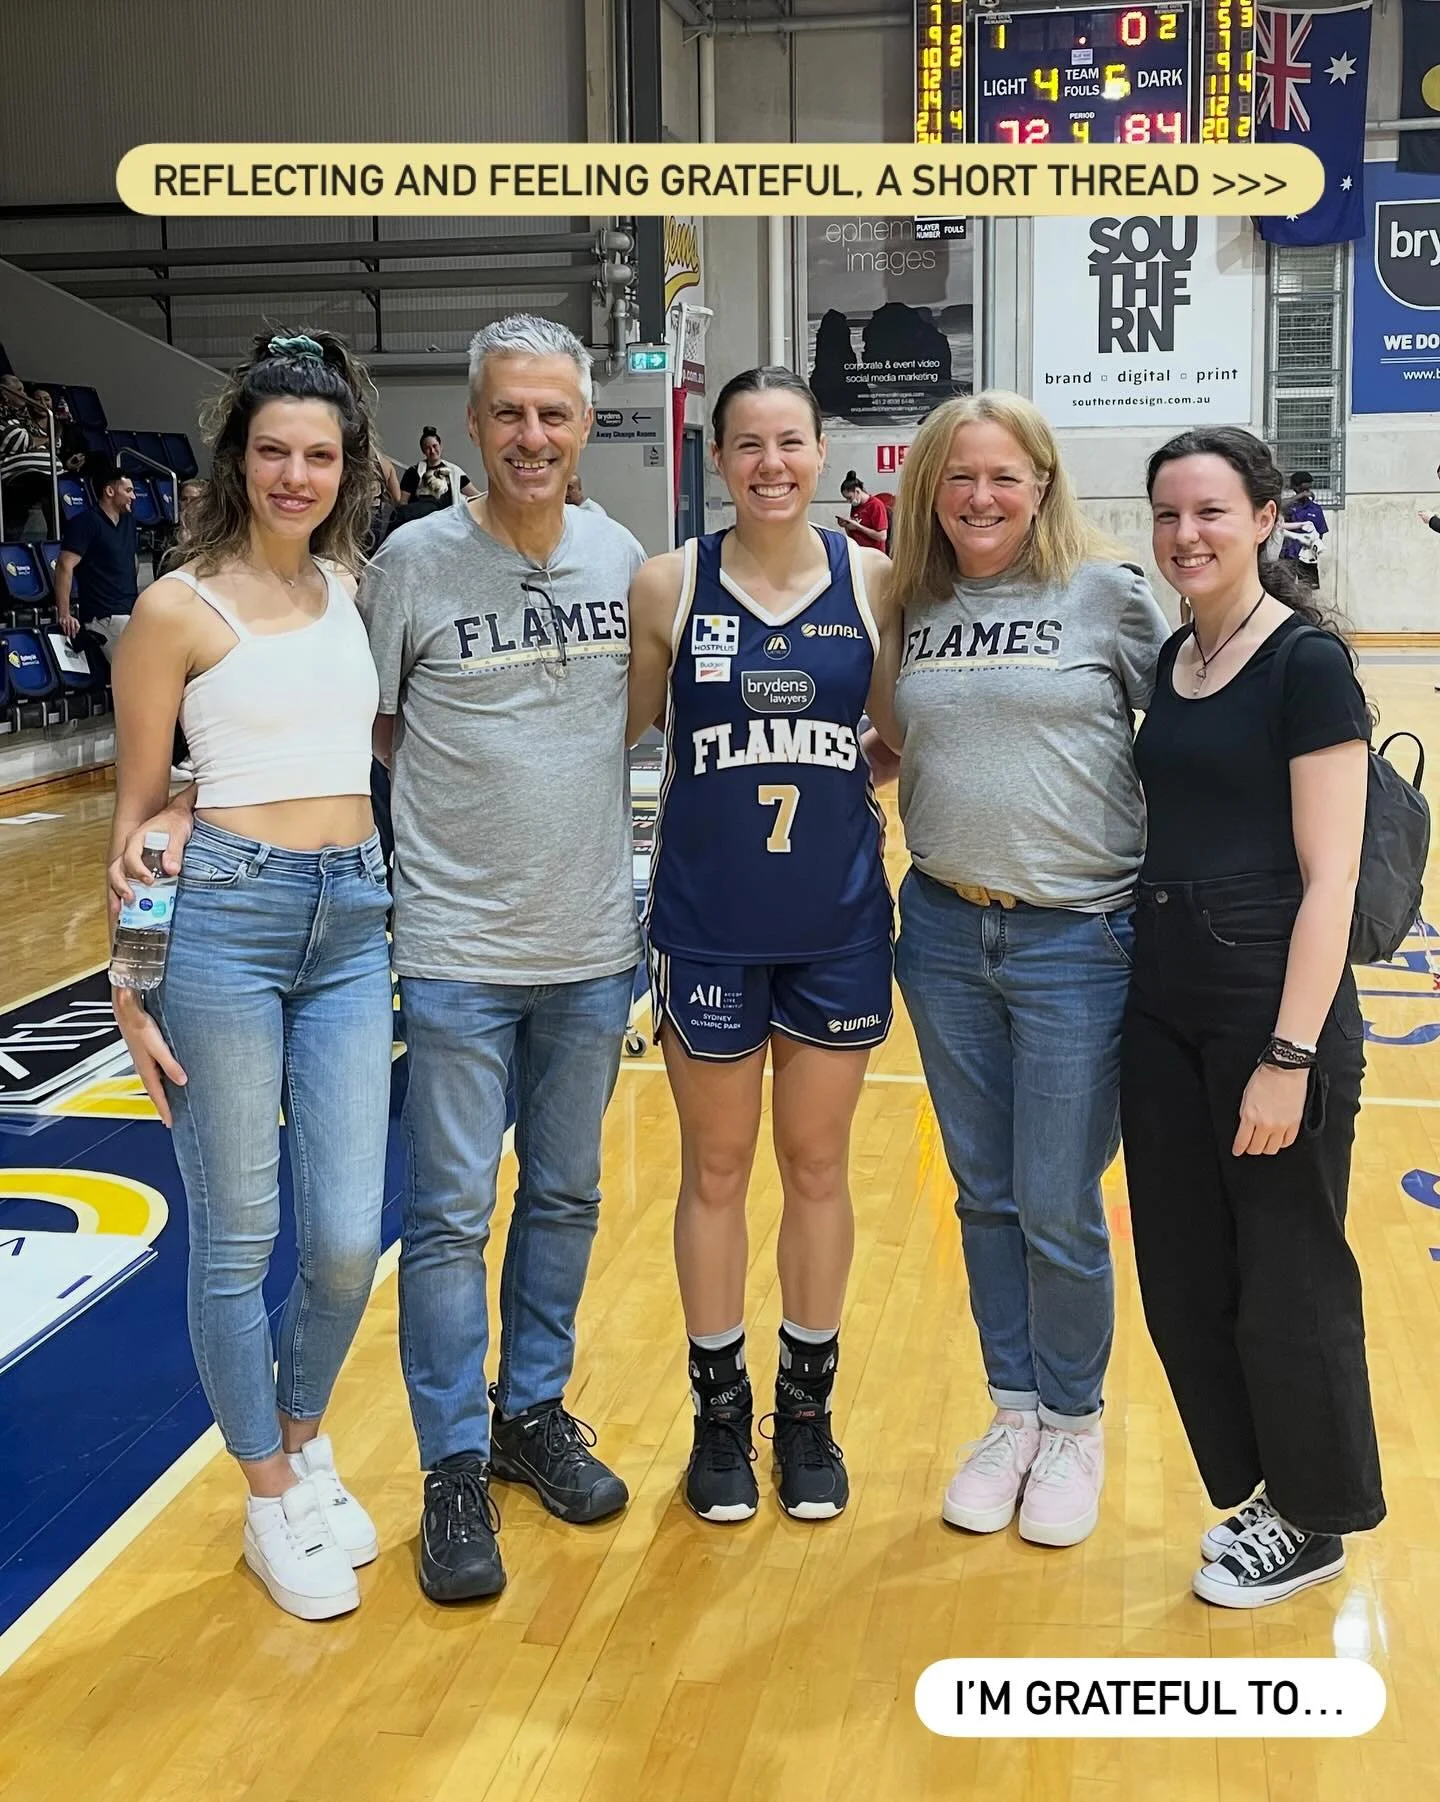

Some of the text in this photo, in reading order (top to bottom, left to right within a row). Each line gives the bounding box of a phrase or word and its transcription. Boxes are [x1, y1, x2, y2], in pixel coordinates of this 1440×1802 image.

[928, 24, 962, 46] 9 2
[1159, 13, 1177, 40] 2
[1218, 29, 1231, 51] 7
[923, 46, 962, 68] 10 2
[1217, 52, 1231, 73] 9
[923, 69, 942, 89] 12
[1065, 67, 1099, 81] TEAM
[1137, 69, 1183, 89] DARK
[1210, 73, 1251, 95] 11 4
[983, 78, 1028, 96] LIGHT
[1034, 67, 1059, 102] 4
[1064, 85, 1100, 97] FOULS
[923, 89, 942, 111] 14
[1210, 95, 1230, 117] 12
[916, 109, 962, 132] 21 4
[1069, 111, 1095, 120] PERIOD
[1202, 116, 1251, 139] 20 2
[916, 223, 939, 232] PLAYER
[916, 231, 941, 239] NUMBER
[944, 225, 964, 234] FOULS
[847, 247, 936, 276] images
[1098, 306, 1174, 353] RN
[1383, 334, 1412, 350] WE
[843, 359, 940, 371] corporate & event video
[845, 372, 938, 383] social media marketing
[1045, 367, 1239, 386] brand digital print
[1072, 396, 1211, 407] southerndesign.com.au
[453, 600, 628, 658] FLAMES
[817, 624, 864, 639] WNBL
[694, 644, 734, 652] HOSTPLUS
[902, 620, 1063, 668] FLAMES
[747, 677, 808, 697] brydens
[770, 693, 807, 705] lawyers
[692, 718, 858, 776] FLAMES
[757, 784, 801, 853] 7
[690, 1019, 723, 1029] OLYMPIC
[702, 1012, 732, 1022] SYDNEY
[843, 1013, 882, 1032] WNBL
